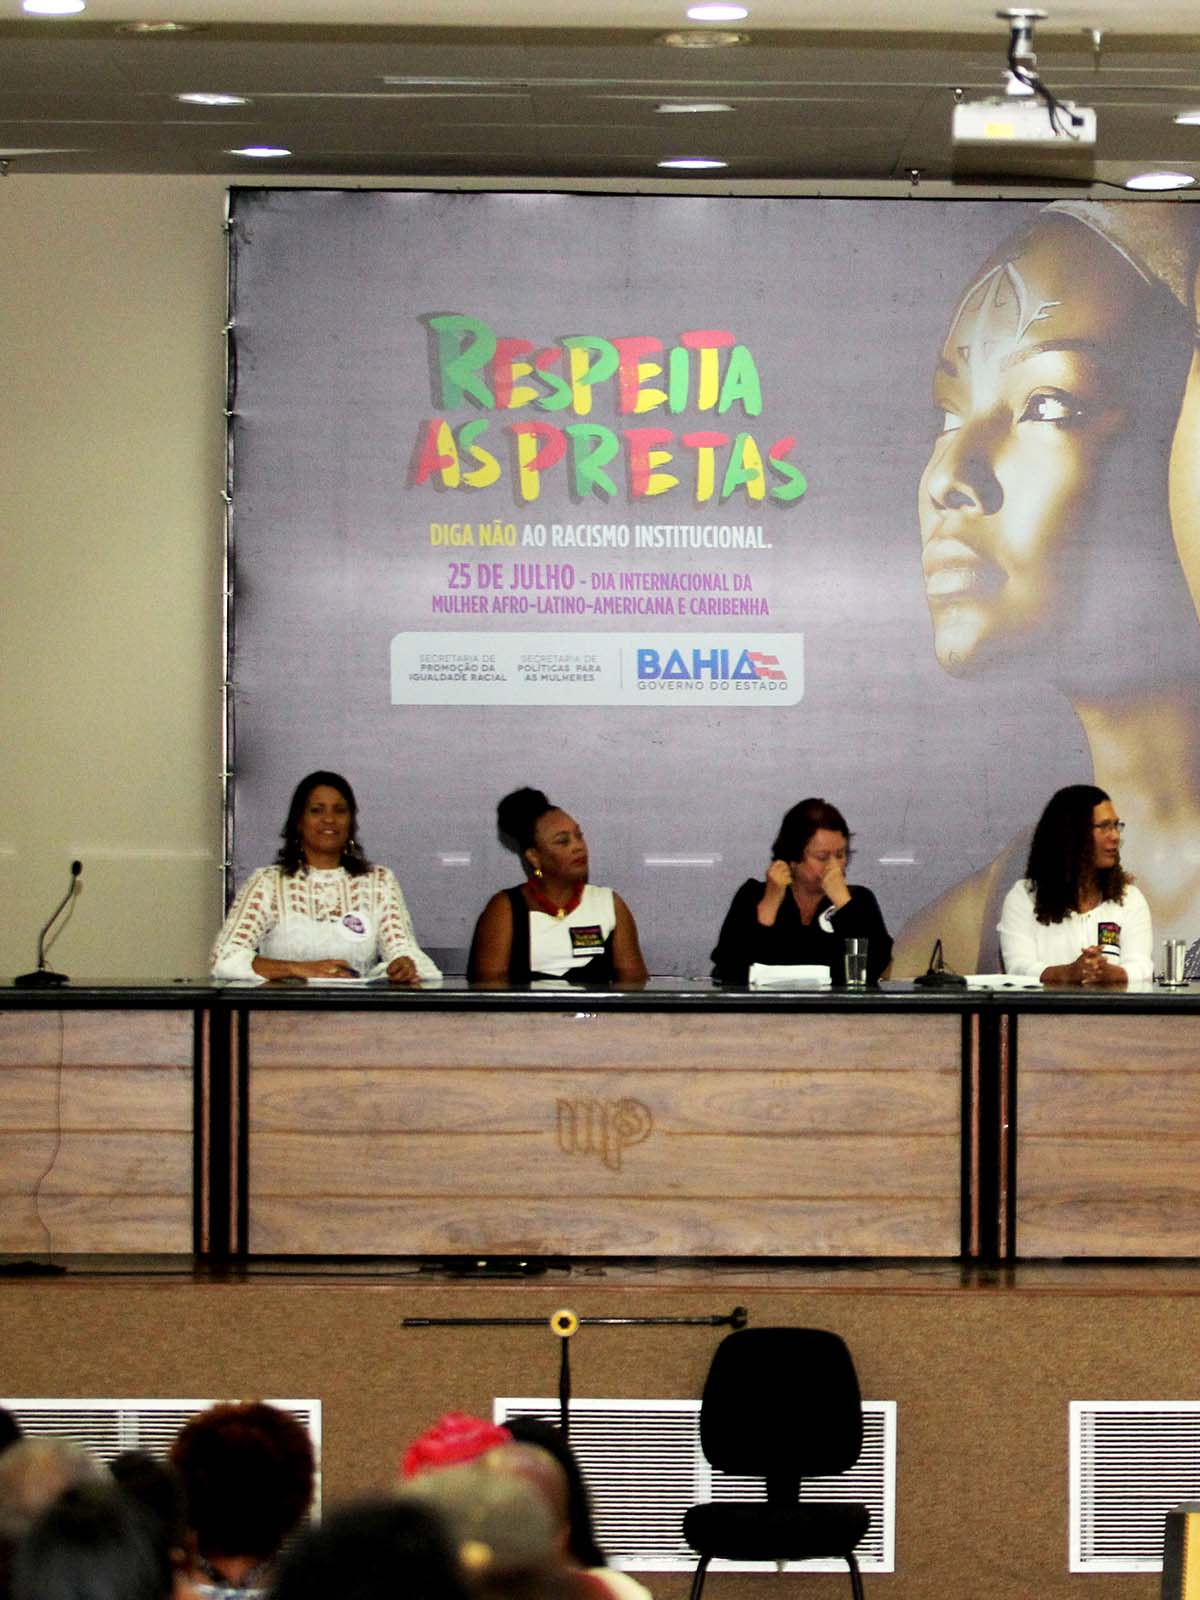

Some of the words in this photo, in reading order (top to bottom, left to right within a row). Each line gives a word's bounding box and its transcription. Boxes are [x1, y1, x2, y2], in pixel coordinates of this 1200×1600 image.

[428, 313, 763, 417] RESPEITA
[414, 417, 502, 489] AS
[510, 421, 808, 502] PRETAS
[429, 523, 474, 547] DIGA
[478, 519, 517, 547] NÃO
[521, 523, 547, 548] AO
[551, 523, 630, 549] RACISMO
[635, 524, 773, 549] INSTITUCIONAL.
[448, 562, 472, 590] 25
[477, 562, 504, 590] DE
[509, 563, 576, 591] JULHO
[591, 572, 616, 591] DIA
[619, 572, 730, 592] INTERNACIONAL
[733, 573, 753, 592] DA
[431, 595, 489, 614] MULHER
[491, 596, 675, 616] AFRO-LATINO-AMERICANA
[678, 597, 687, 616] E
[690, 597, 770, 616] CARIBENHA
[418, 653, 479, 664] SECRETARIA
[482, 653, 496, 664] DE
[520, 653, 581, 664] SECRETARIA
[584, 653, 598, 664] DE
[636, 648, 763, 681] BAHIA
[420, 662, 479, 674] PROMOÇÃO
[481, 663, 496, 673] DA
[517, 662, 570, 673] POLÍTICAS
[576, 664, 602, 673] PARA
[408, 673, 468, 682] IGUALDADE
[470, 673, 508, 682] RACIAL
[525, 673, 538, 682] AS
[541, 673, 595, 682] MULHERES
[636, 680, 704, 691] GOVERNO
[709, 680, 730, 691] DO
[735, 681, 789, 691] ESTADO
